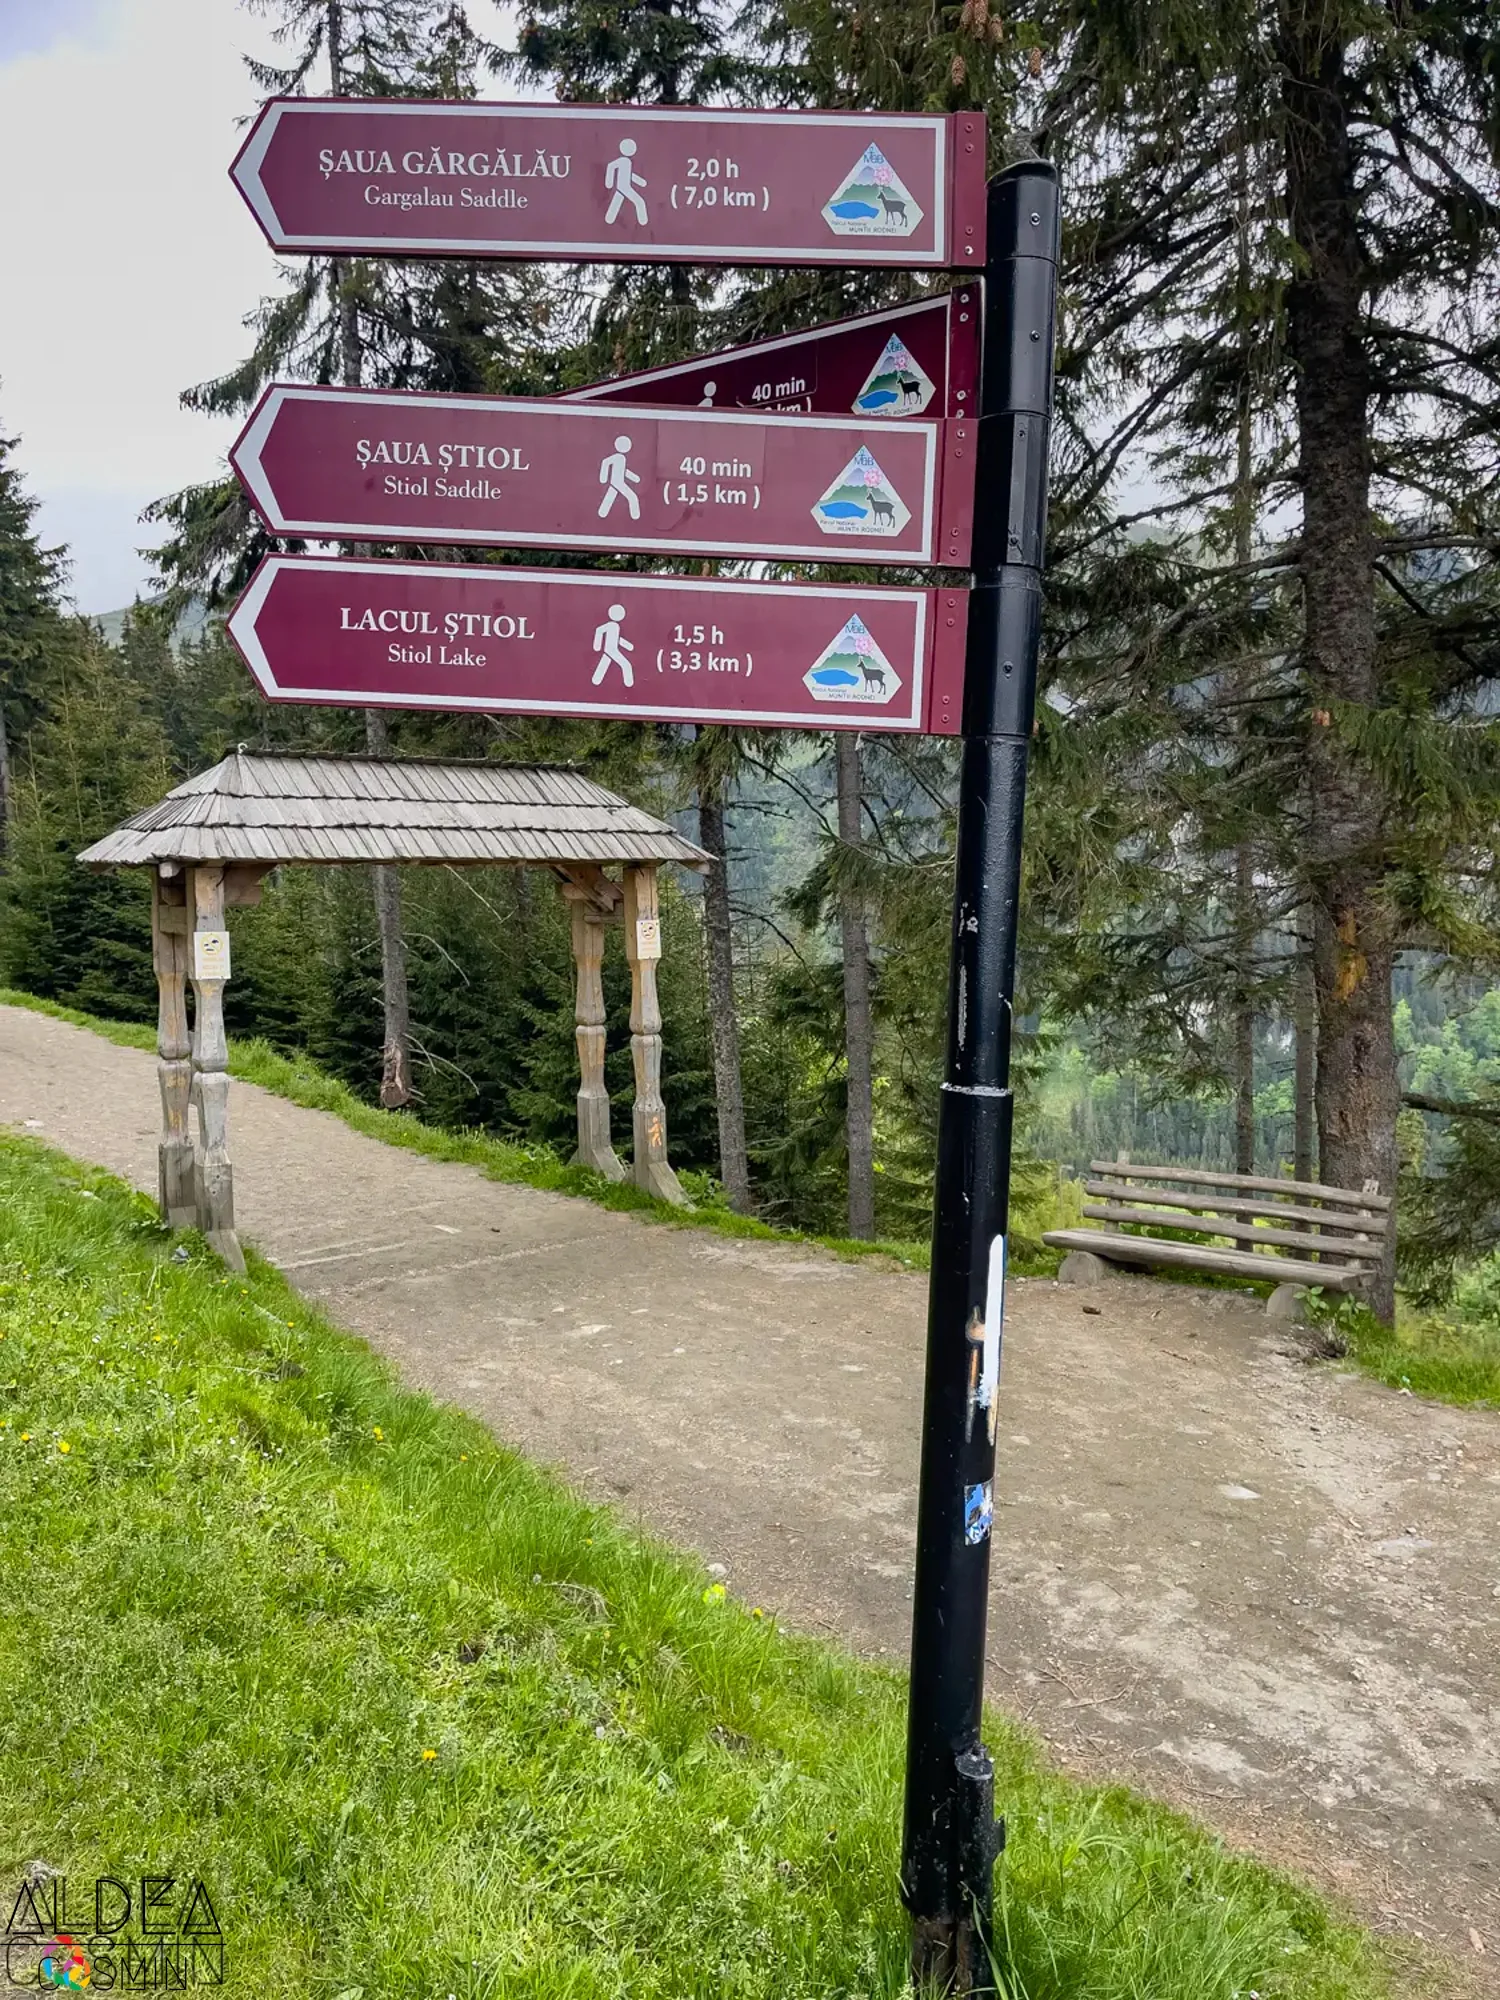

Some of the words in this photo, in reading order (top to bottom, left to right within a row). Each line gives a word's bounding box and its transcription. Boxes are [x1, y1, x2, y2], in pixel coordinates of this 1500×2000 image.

[319, 149, 397, 180] ȘAUA
[402, 146, 572, 179] GĂRGĂLĂU
[687, 158, 720, 181] 2,0
[726, 157, 739, 178] h
[364, 184, 454, 211] Gargalau
[460, 187, 528, 209] Saddle
[751, 383, 772, 402] 40
[775, 376, 806, 397] min
[356, 439, 433, 470] ȘAUA
[438, 444, 530, 474] ȘTIOL
[679, 456, 706, 476] 40
[711, 458, 752, 478] min
[384, 475, 428, 496] Stiol
[435, 477, 501, 500] Saddle
[340, 607, 438, 634] LACUL
[444, 612, 535, 643] ȘTIOL
[674, 624, 705, 647] 1,5
[711, 625, 724, 645] h
[388, 643, 432, 664] Stiol
[439, 646, 487, 667] Lake
